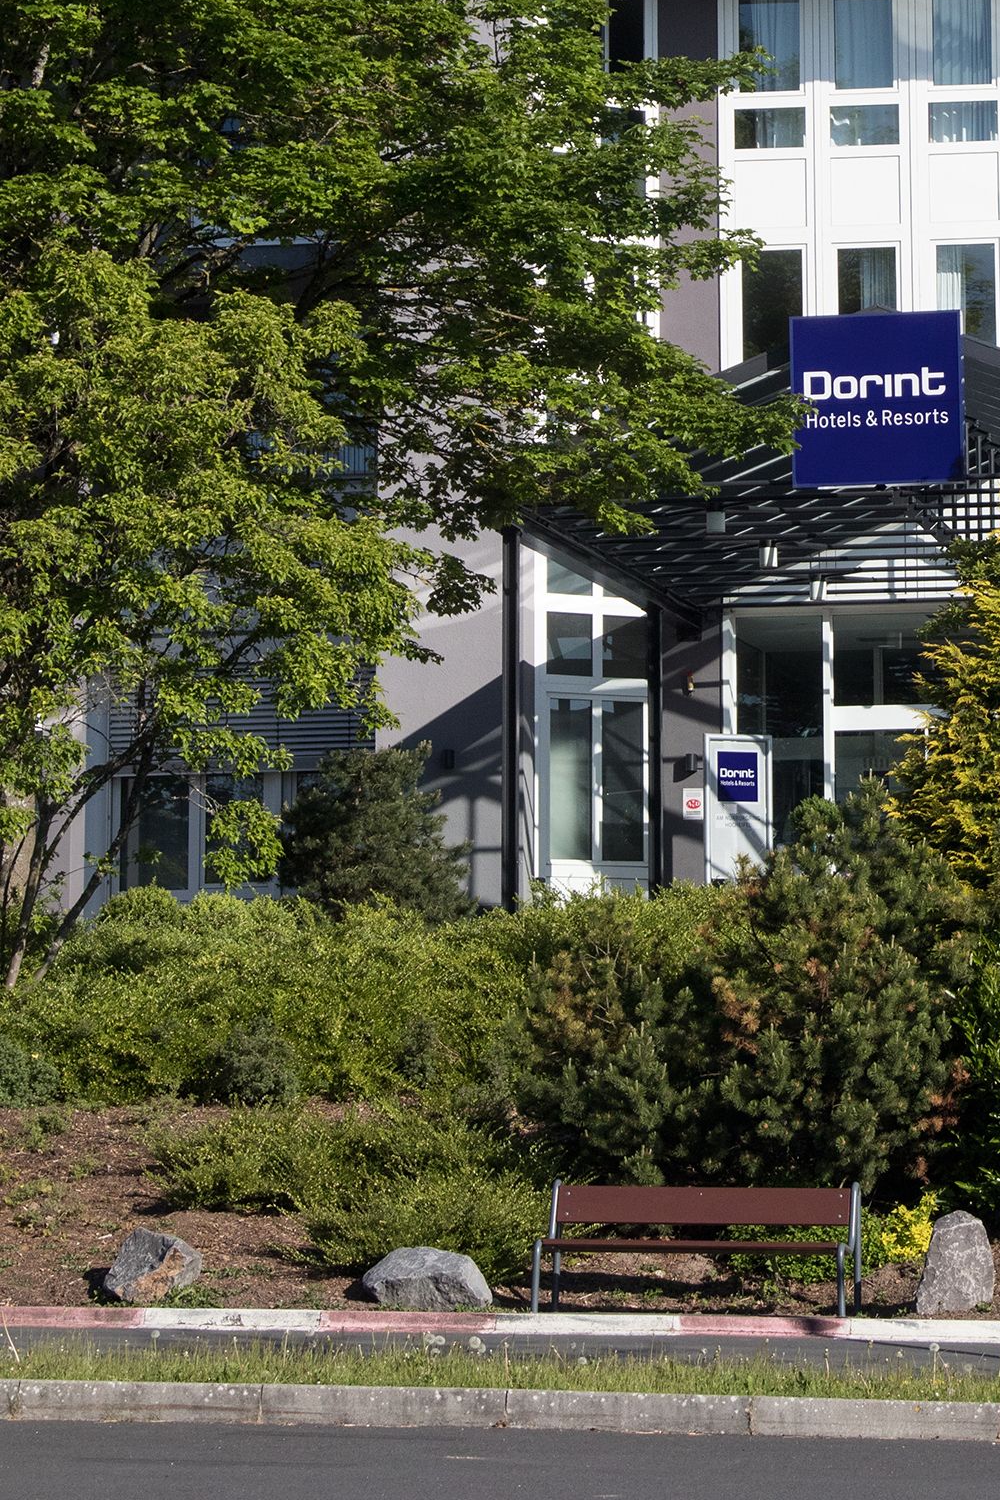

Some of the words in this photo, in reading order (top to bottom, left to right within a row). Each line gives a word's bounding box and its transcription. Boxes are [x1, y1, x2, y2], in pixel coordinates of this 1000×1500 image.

[803, 366, 946, 400] Dorint
[806, 411, 861, 429] Hotels
[865, 410, 878, 427] &
[882, 408, 949, 426] Resorts
[719, 767, 755, 779] Dorint
